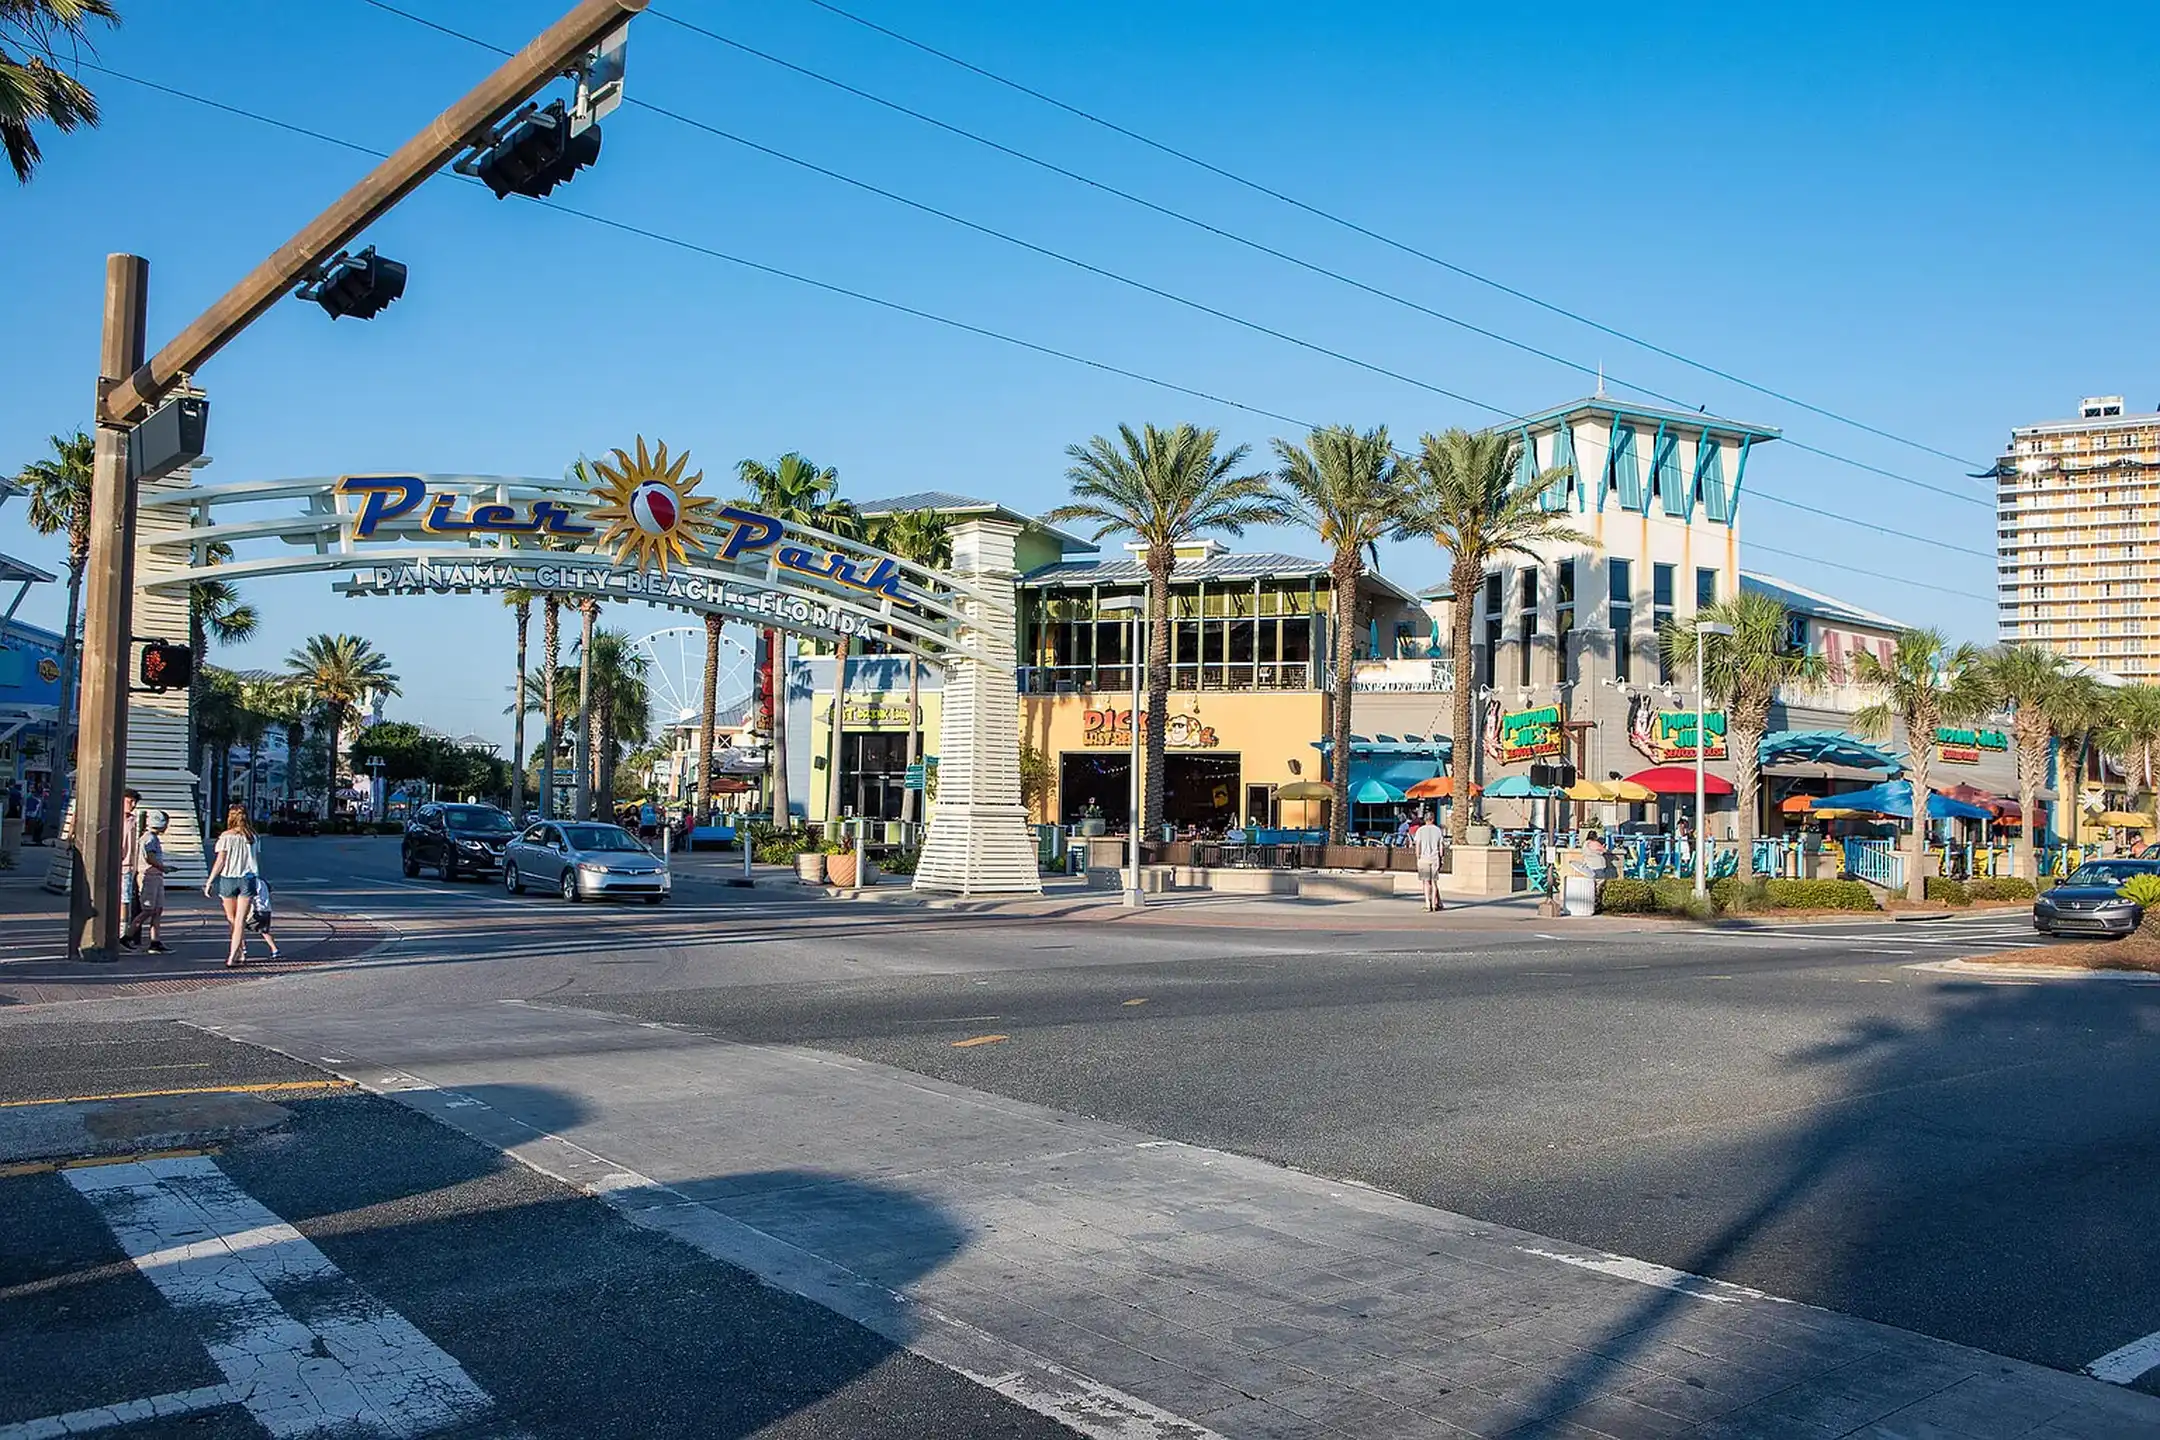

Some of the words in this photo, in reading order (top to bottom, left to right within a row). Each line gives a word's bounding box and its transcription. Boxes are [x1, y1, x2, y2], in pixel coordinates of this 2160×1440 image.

[334, 475, 596, 540] Pier
[714, 505, 919, 609] Park
[373, 563, 523, 589] PANAMA
[535, 565, 613, 590] CITY
[625, 571, 725, 605] BEACH
[758, 593, 873, 641] FLORIDA
[1084, 709, 1168, 732] DICK
[1659, 711, 1726, 741] POMPNO
[1700, 747, 1725, 757] OUSE
